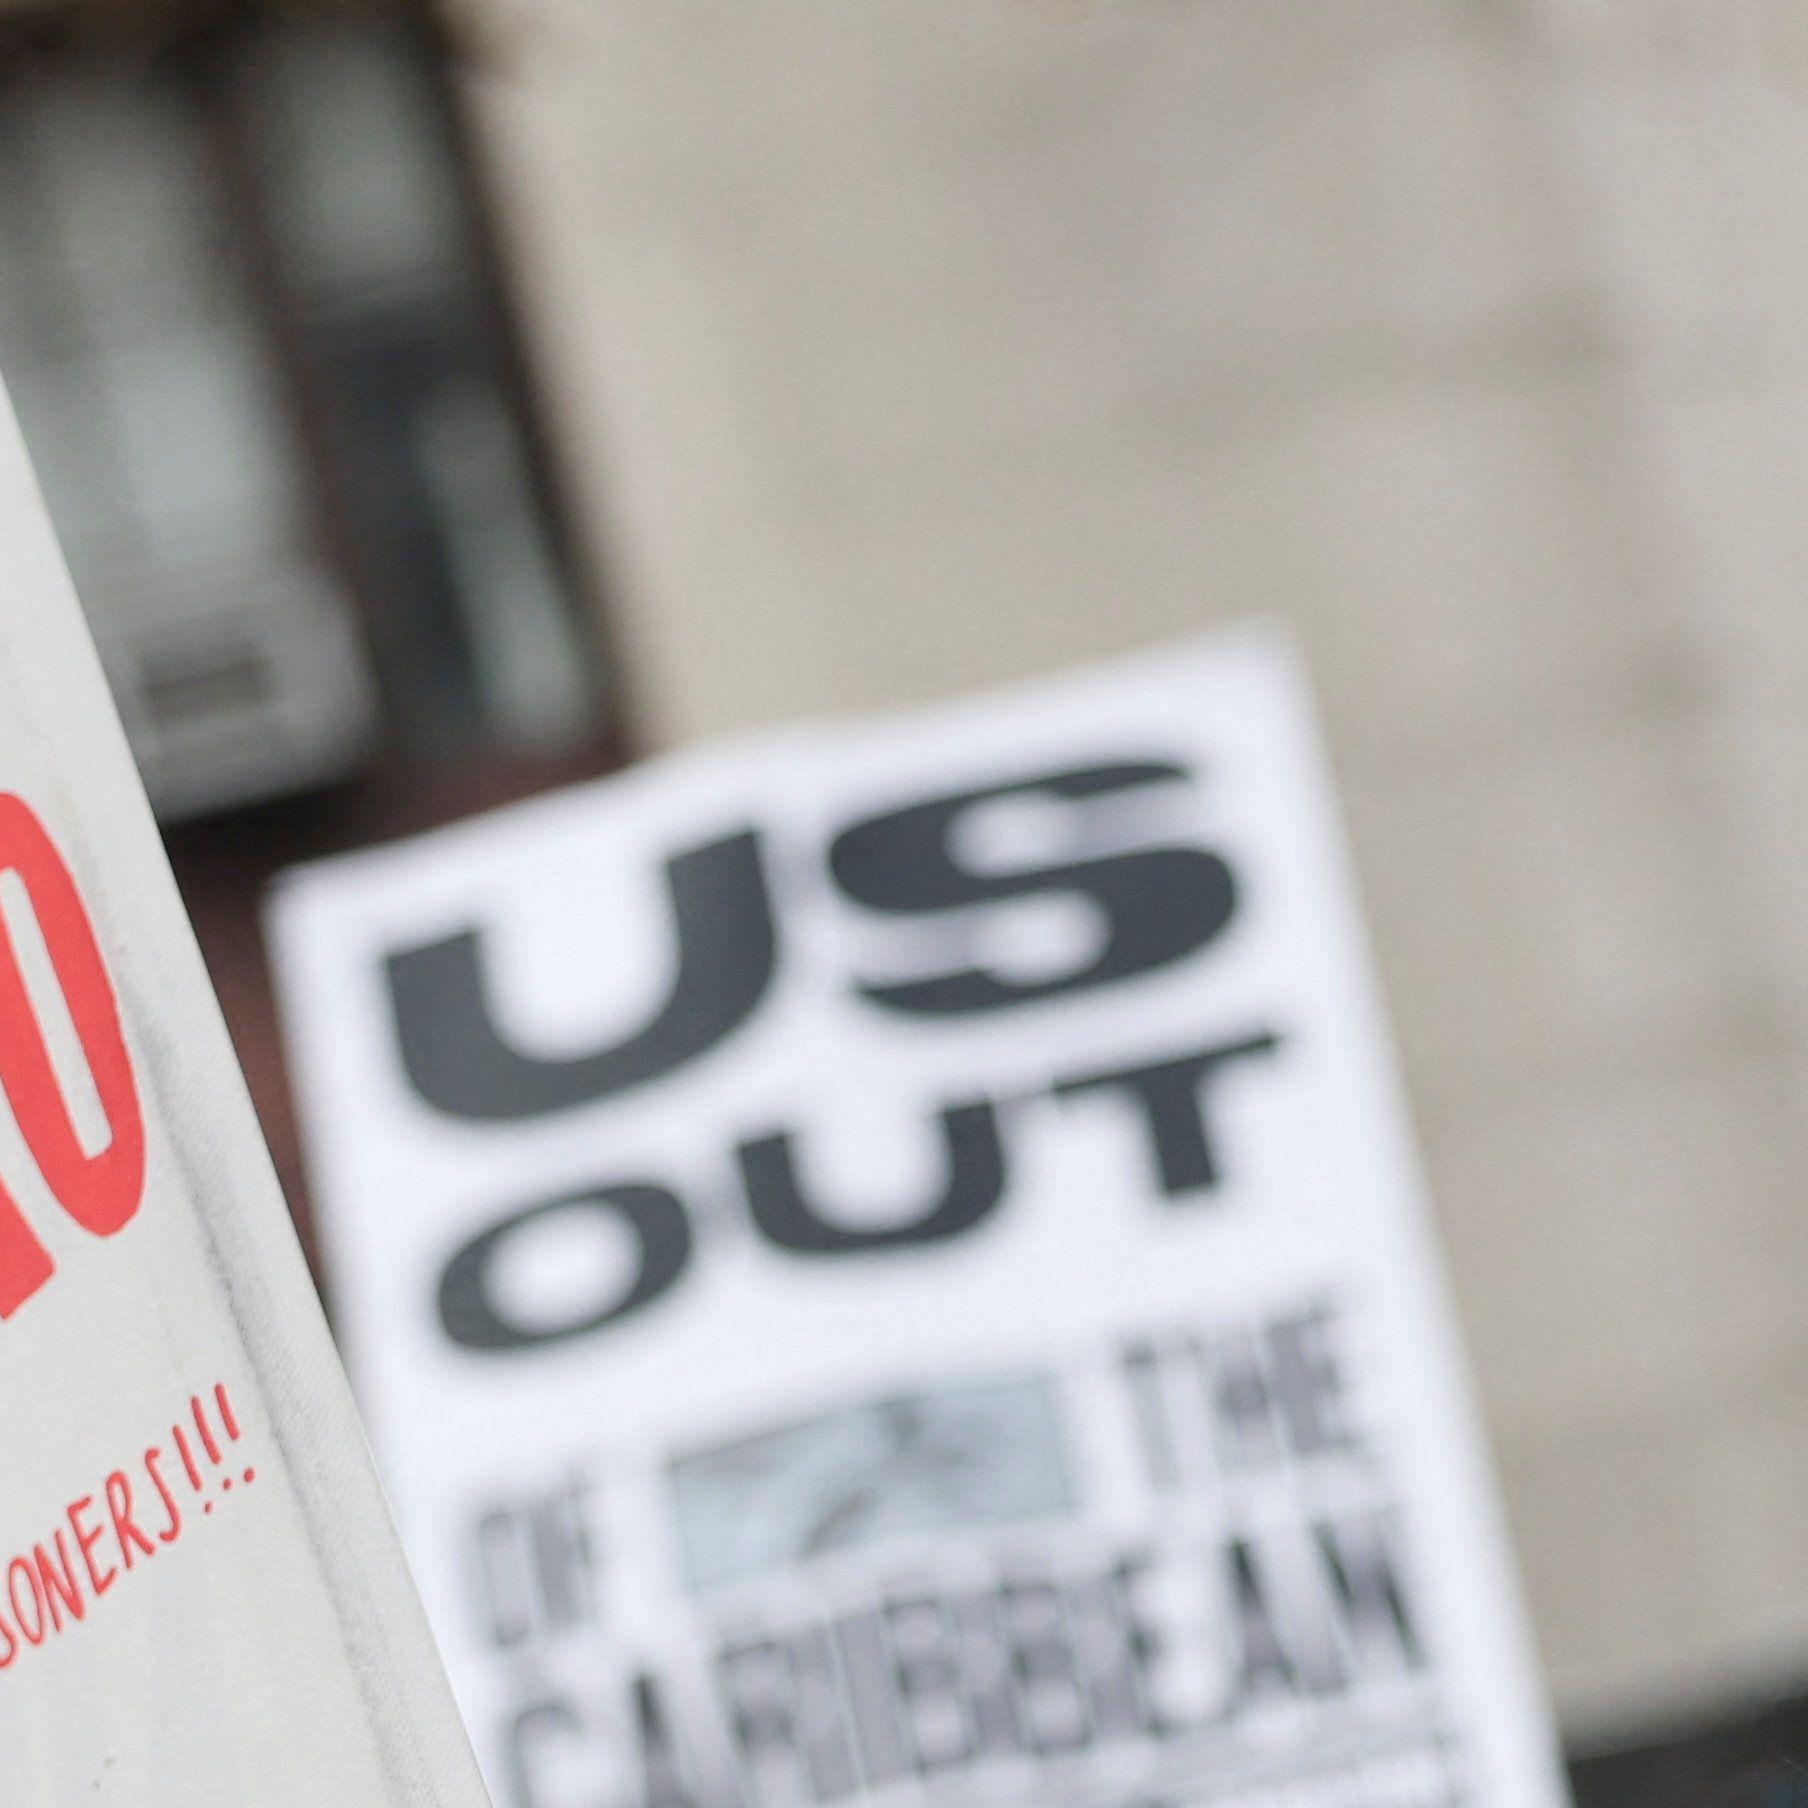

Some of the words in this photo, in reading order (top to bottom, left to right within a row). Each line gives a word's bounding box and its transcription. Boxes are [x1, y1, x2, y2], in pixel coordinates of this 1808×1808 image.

[382, 759, 1239, 1127] US
[434, 1033, 1281, 1355] OUT
[1118, 1299, 1362, 1494] THE
